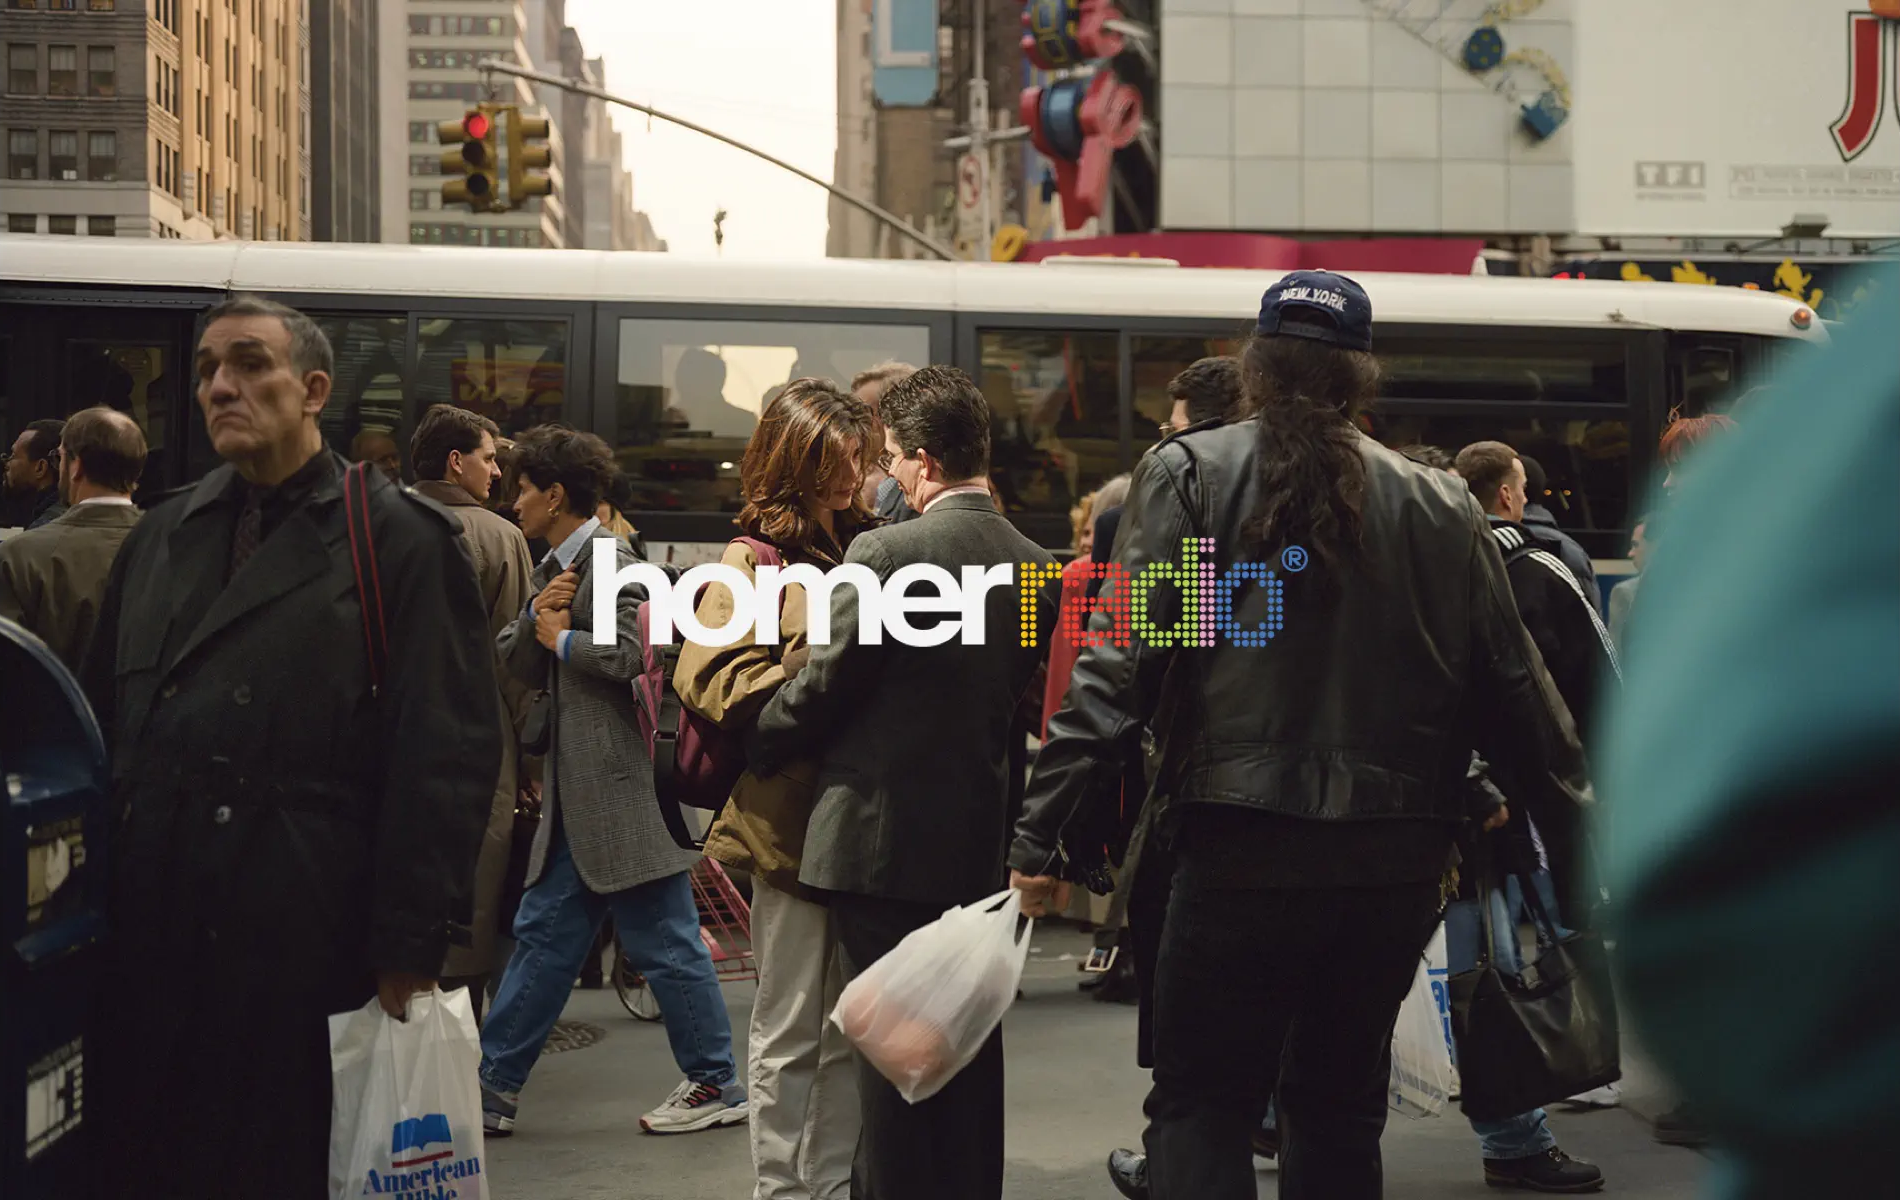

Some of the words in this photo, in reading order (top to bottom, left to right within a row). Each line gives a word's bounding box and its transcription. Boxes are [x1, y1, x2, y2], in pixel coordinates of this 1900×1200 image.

[1829, 11, 1900, 163] J
[1279, 286, 1312, 302] NEW
[1313, 287, 1348, 312] YORK
[363, 1157, 480, 1195] American
